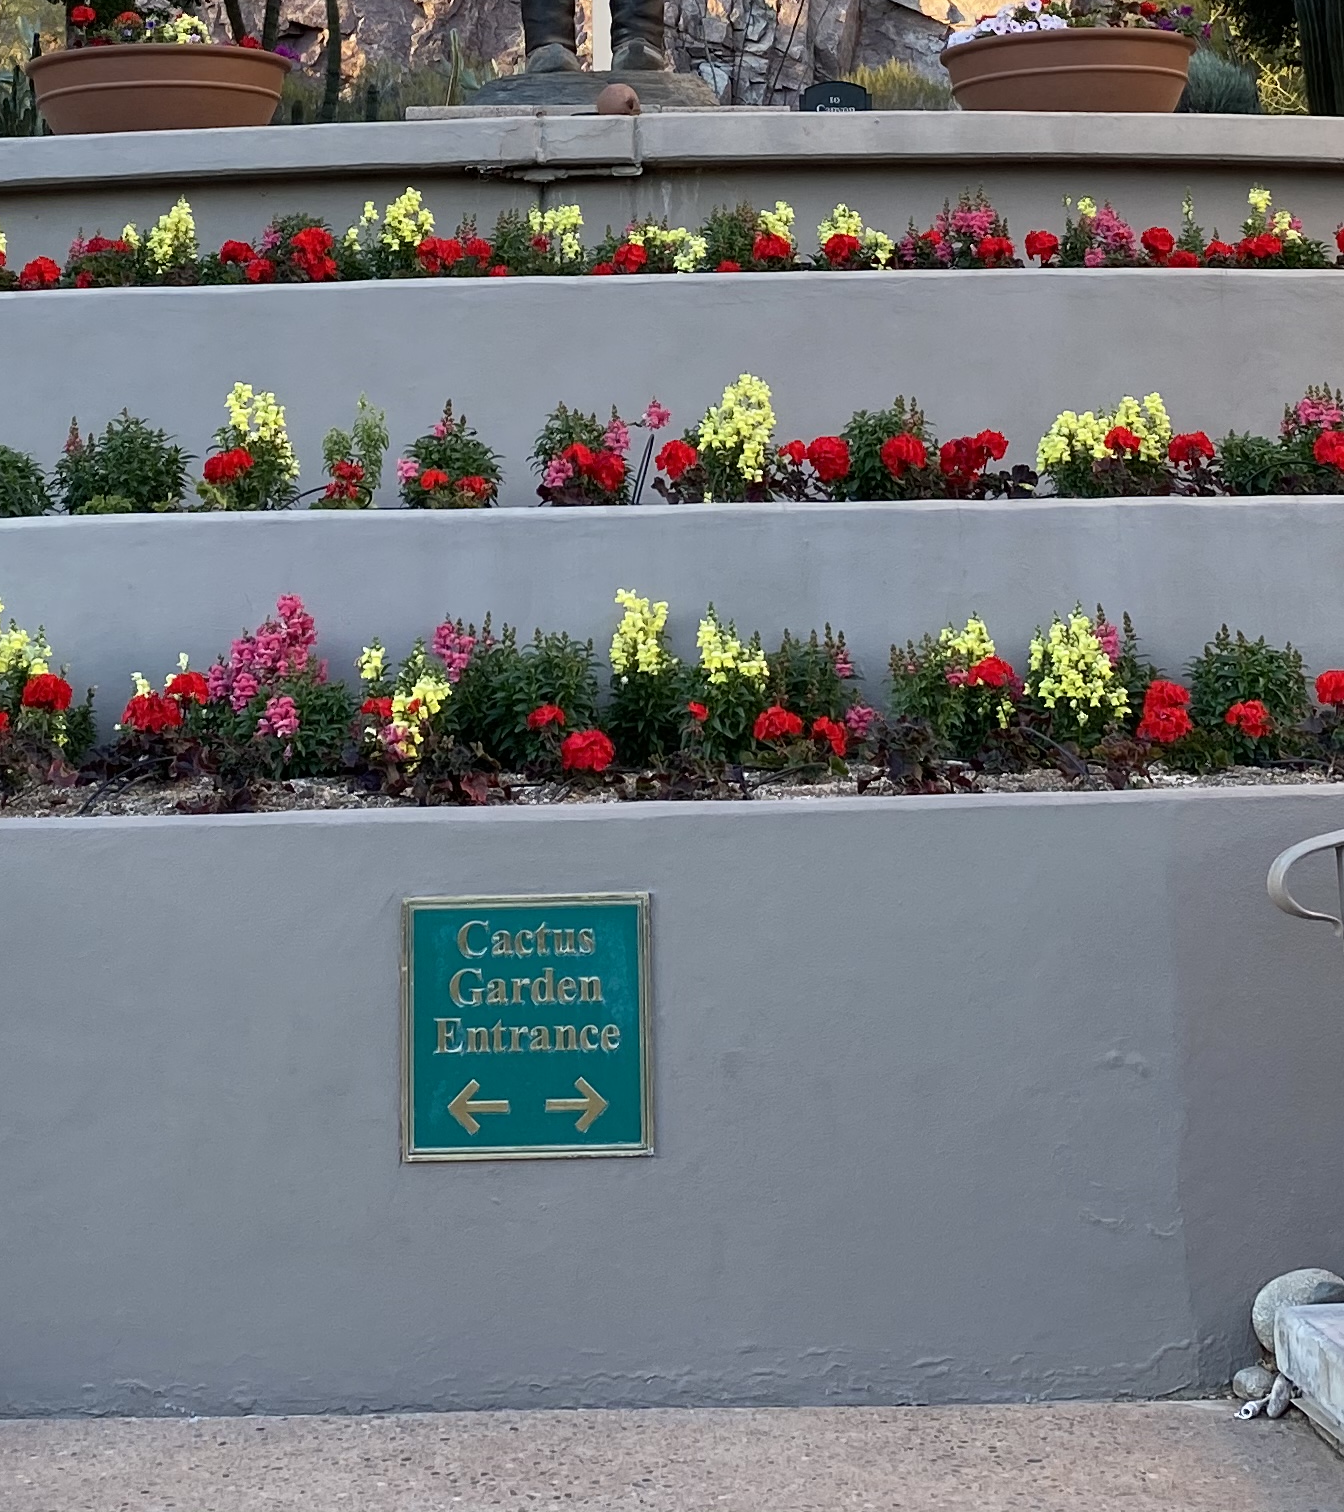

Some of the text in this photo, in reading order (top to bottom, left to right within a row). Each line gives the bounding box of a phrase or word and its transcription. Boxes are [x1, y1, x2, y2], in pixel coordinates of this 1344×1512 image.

[457, 920, 596, 959] Cactus
[449, 967, 605, 1007] Garden
[433, 1016, 621, 1055] Entrance
